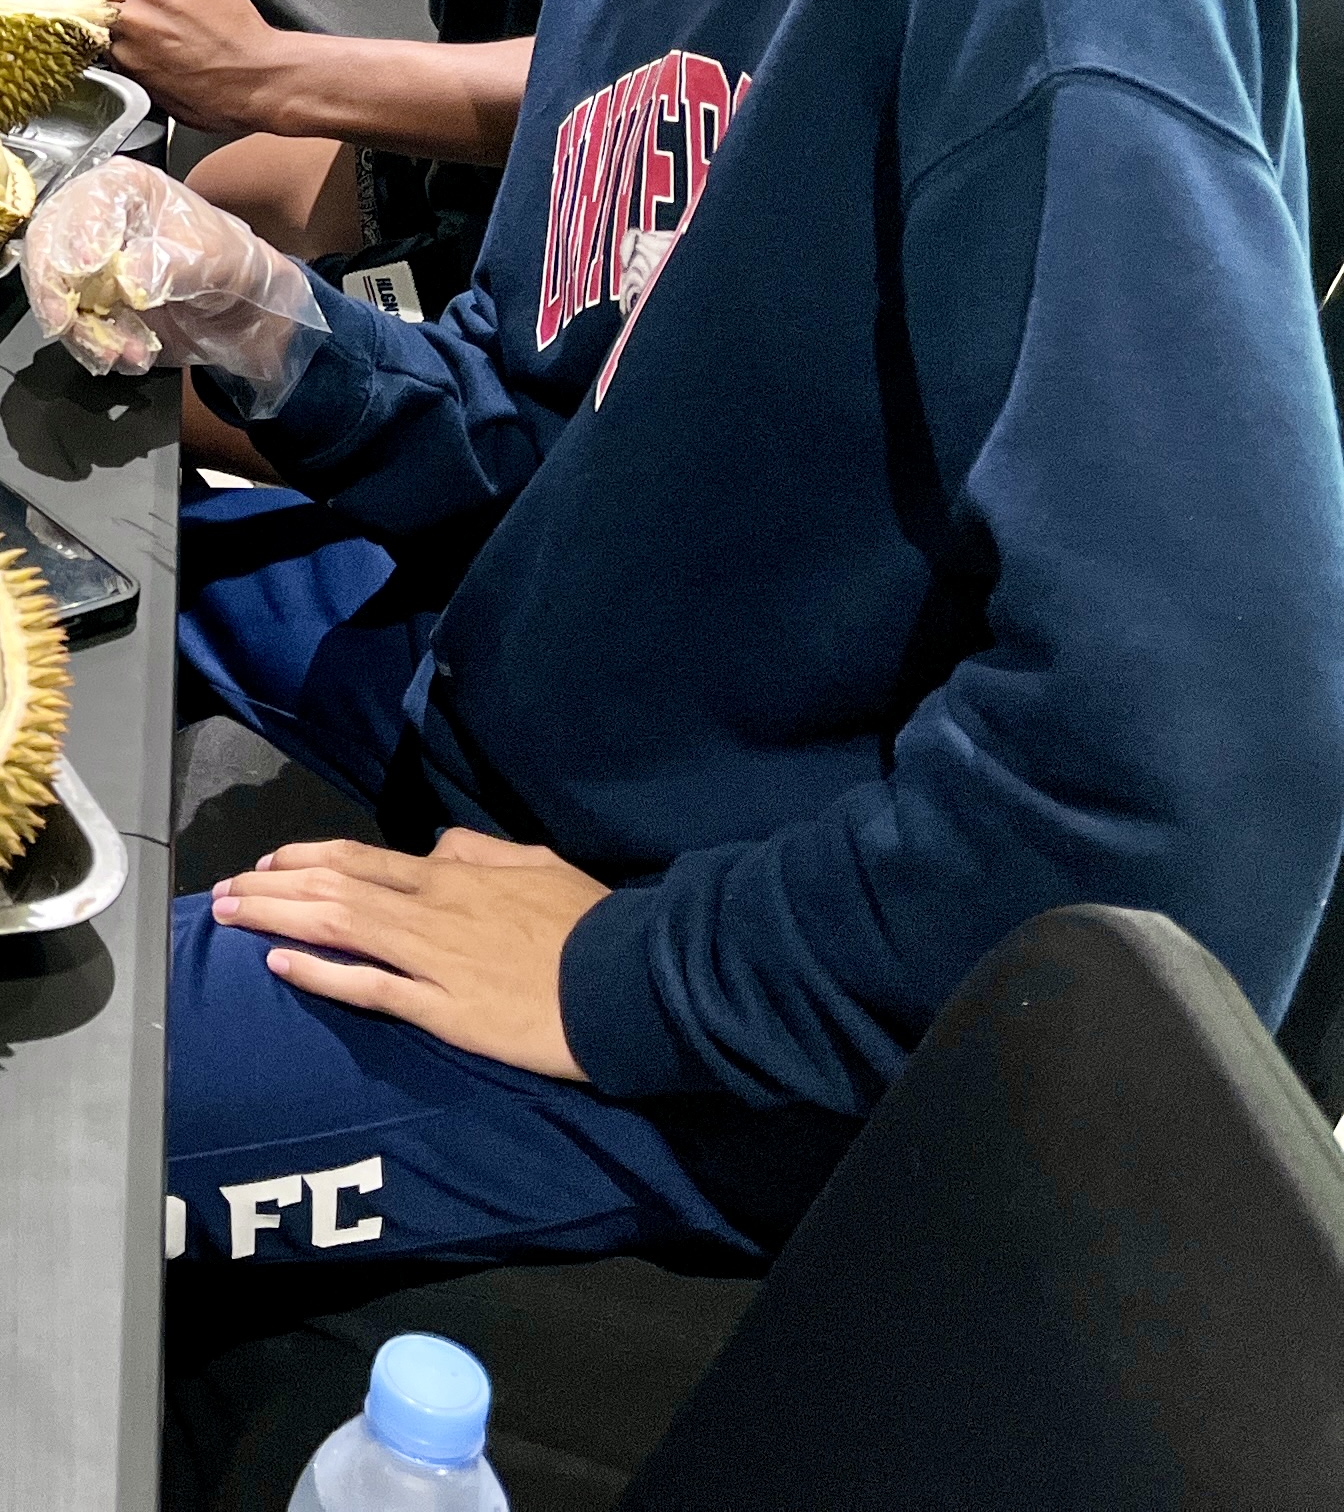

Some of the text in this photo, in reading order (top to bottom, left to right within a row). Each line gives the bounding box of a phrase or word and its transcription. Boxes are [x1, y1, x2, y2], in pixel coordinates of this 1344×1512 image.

[536, 49, 752, 352] UNIVER
[374, 277, 401, 317] HLGN
[218, 1155, 384, 1260] FC
